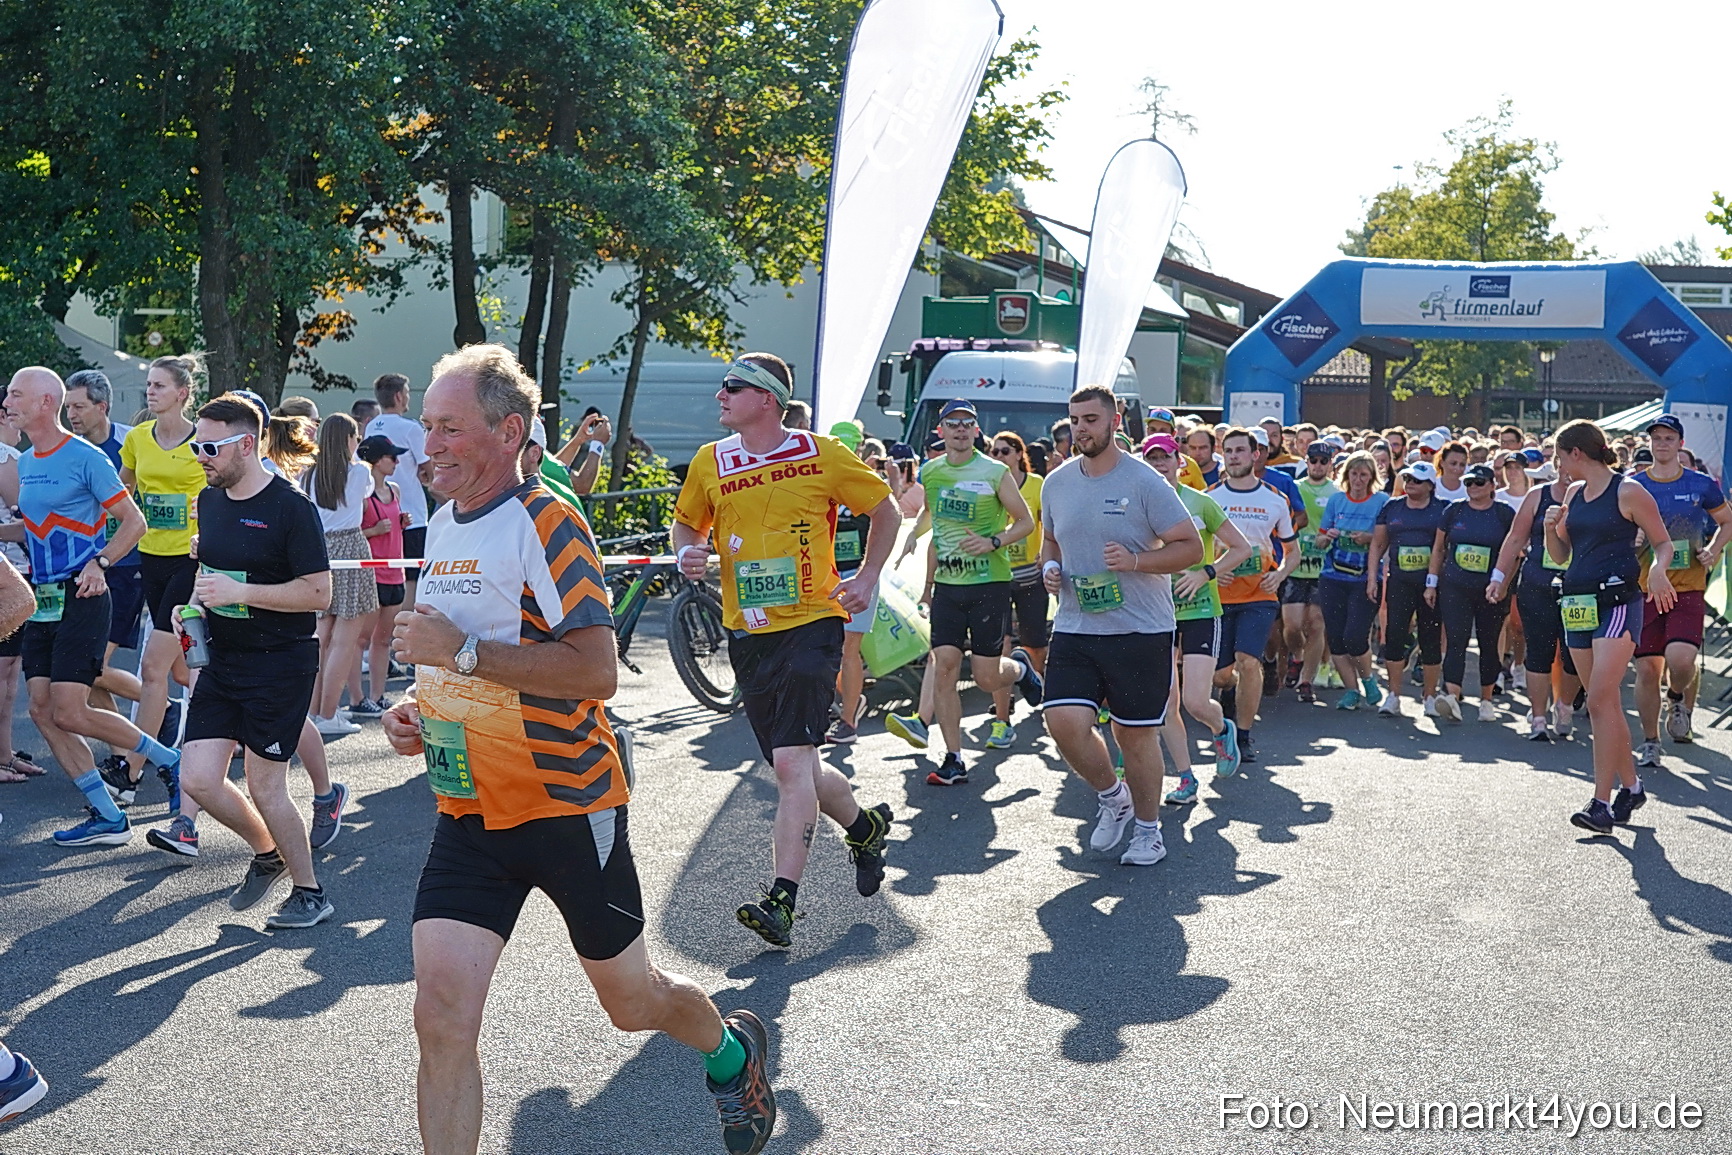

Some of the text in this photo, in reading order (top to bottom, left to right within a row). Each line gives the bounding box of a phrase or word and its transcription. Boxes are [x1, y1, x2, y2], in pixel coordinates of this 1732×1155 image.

[1454, 298, 1545, 316] firmenlauf
[1280, 320, 1330, 335] Fischer
[720, 463, 823, 496] MAX BÖGL
[152, 506, 175, 518] 549
[943, 498, 969, 512] 1459
[1229, 506, 1269, 514] KLEBL
[1228, 512, 1270, 521] DYNAMICS
[1405, 555, 1424, 564] 483
[1463, 553, 1482, 564] 492
[431, 559, 482, 576] KLEBL
[425, 579, 482, 595] DYNAMICS
[739, 582, 747, 600] RUN
[745, 574, 787, 593] 1584
[787, 575, 796, 598] 2022
[1083, 586, 1106, 601] 647
[1568, 607, 1587, 619] 487
[424, 741, 450, 772] 04
[436, 772, 461, 784] Roland
[455, 753, 471, 789] 2022
